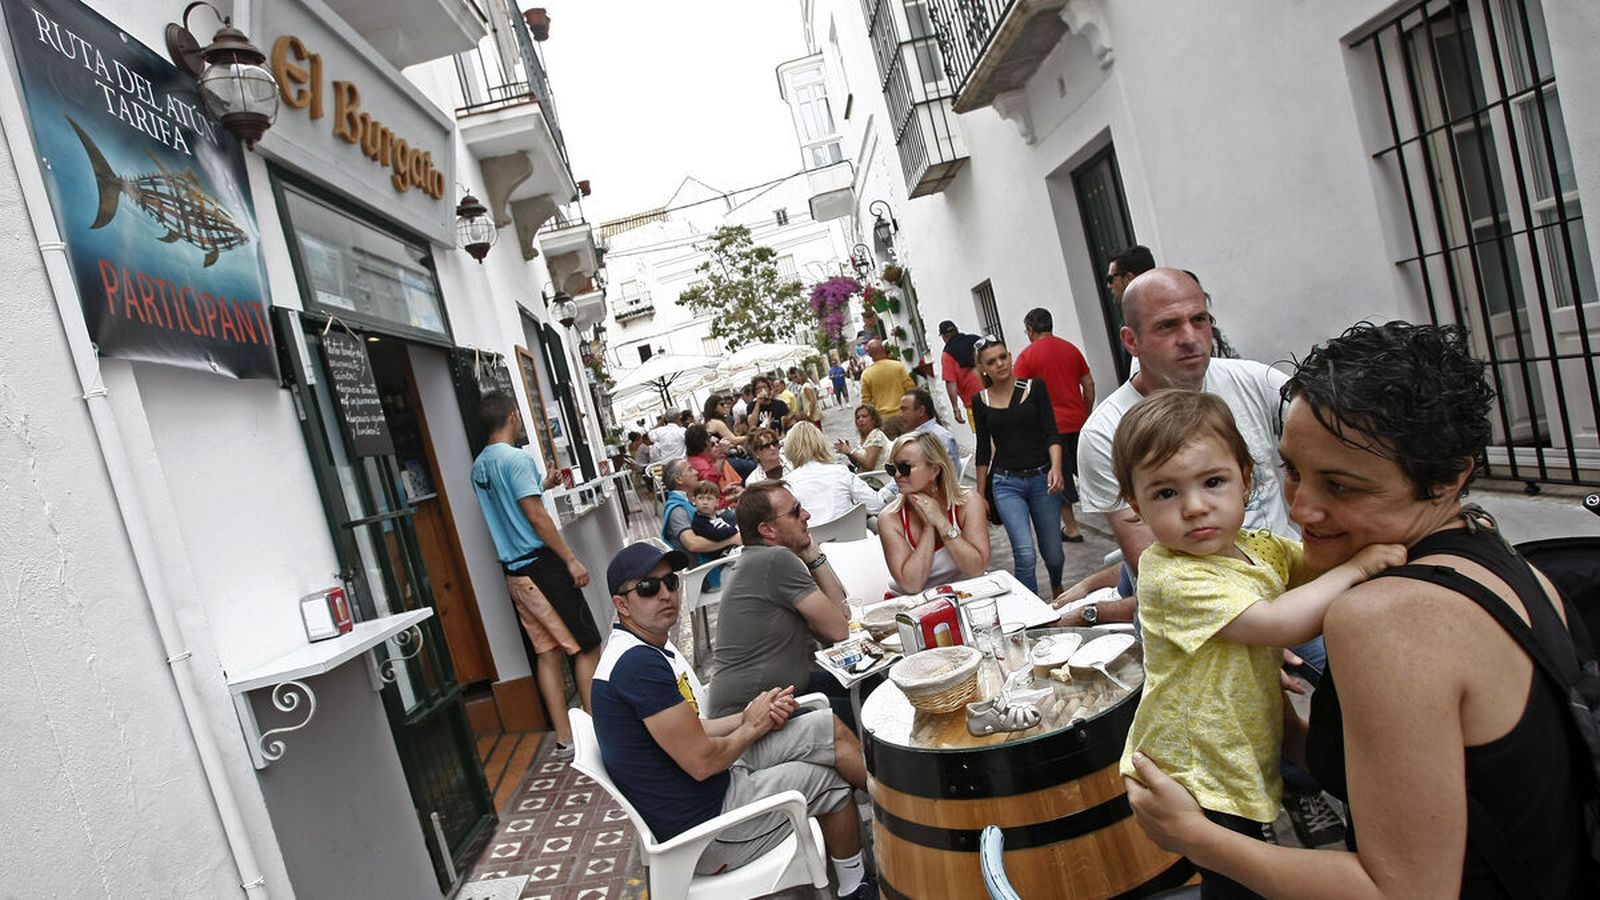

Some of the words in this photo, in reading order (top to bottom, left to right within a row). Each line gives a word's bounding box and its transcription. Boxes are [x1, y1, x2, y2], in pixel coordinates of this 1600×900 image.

[31, 7, 114, 84] RUTA
[112, 59, 164, 113] DEL
[94, 79, 192, 156] TARIFA
[271, 35, 324, 120] El
[332, 80, 445, 200] Burgato
[97, 257, 274, 347] PARTICIPANT
